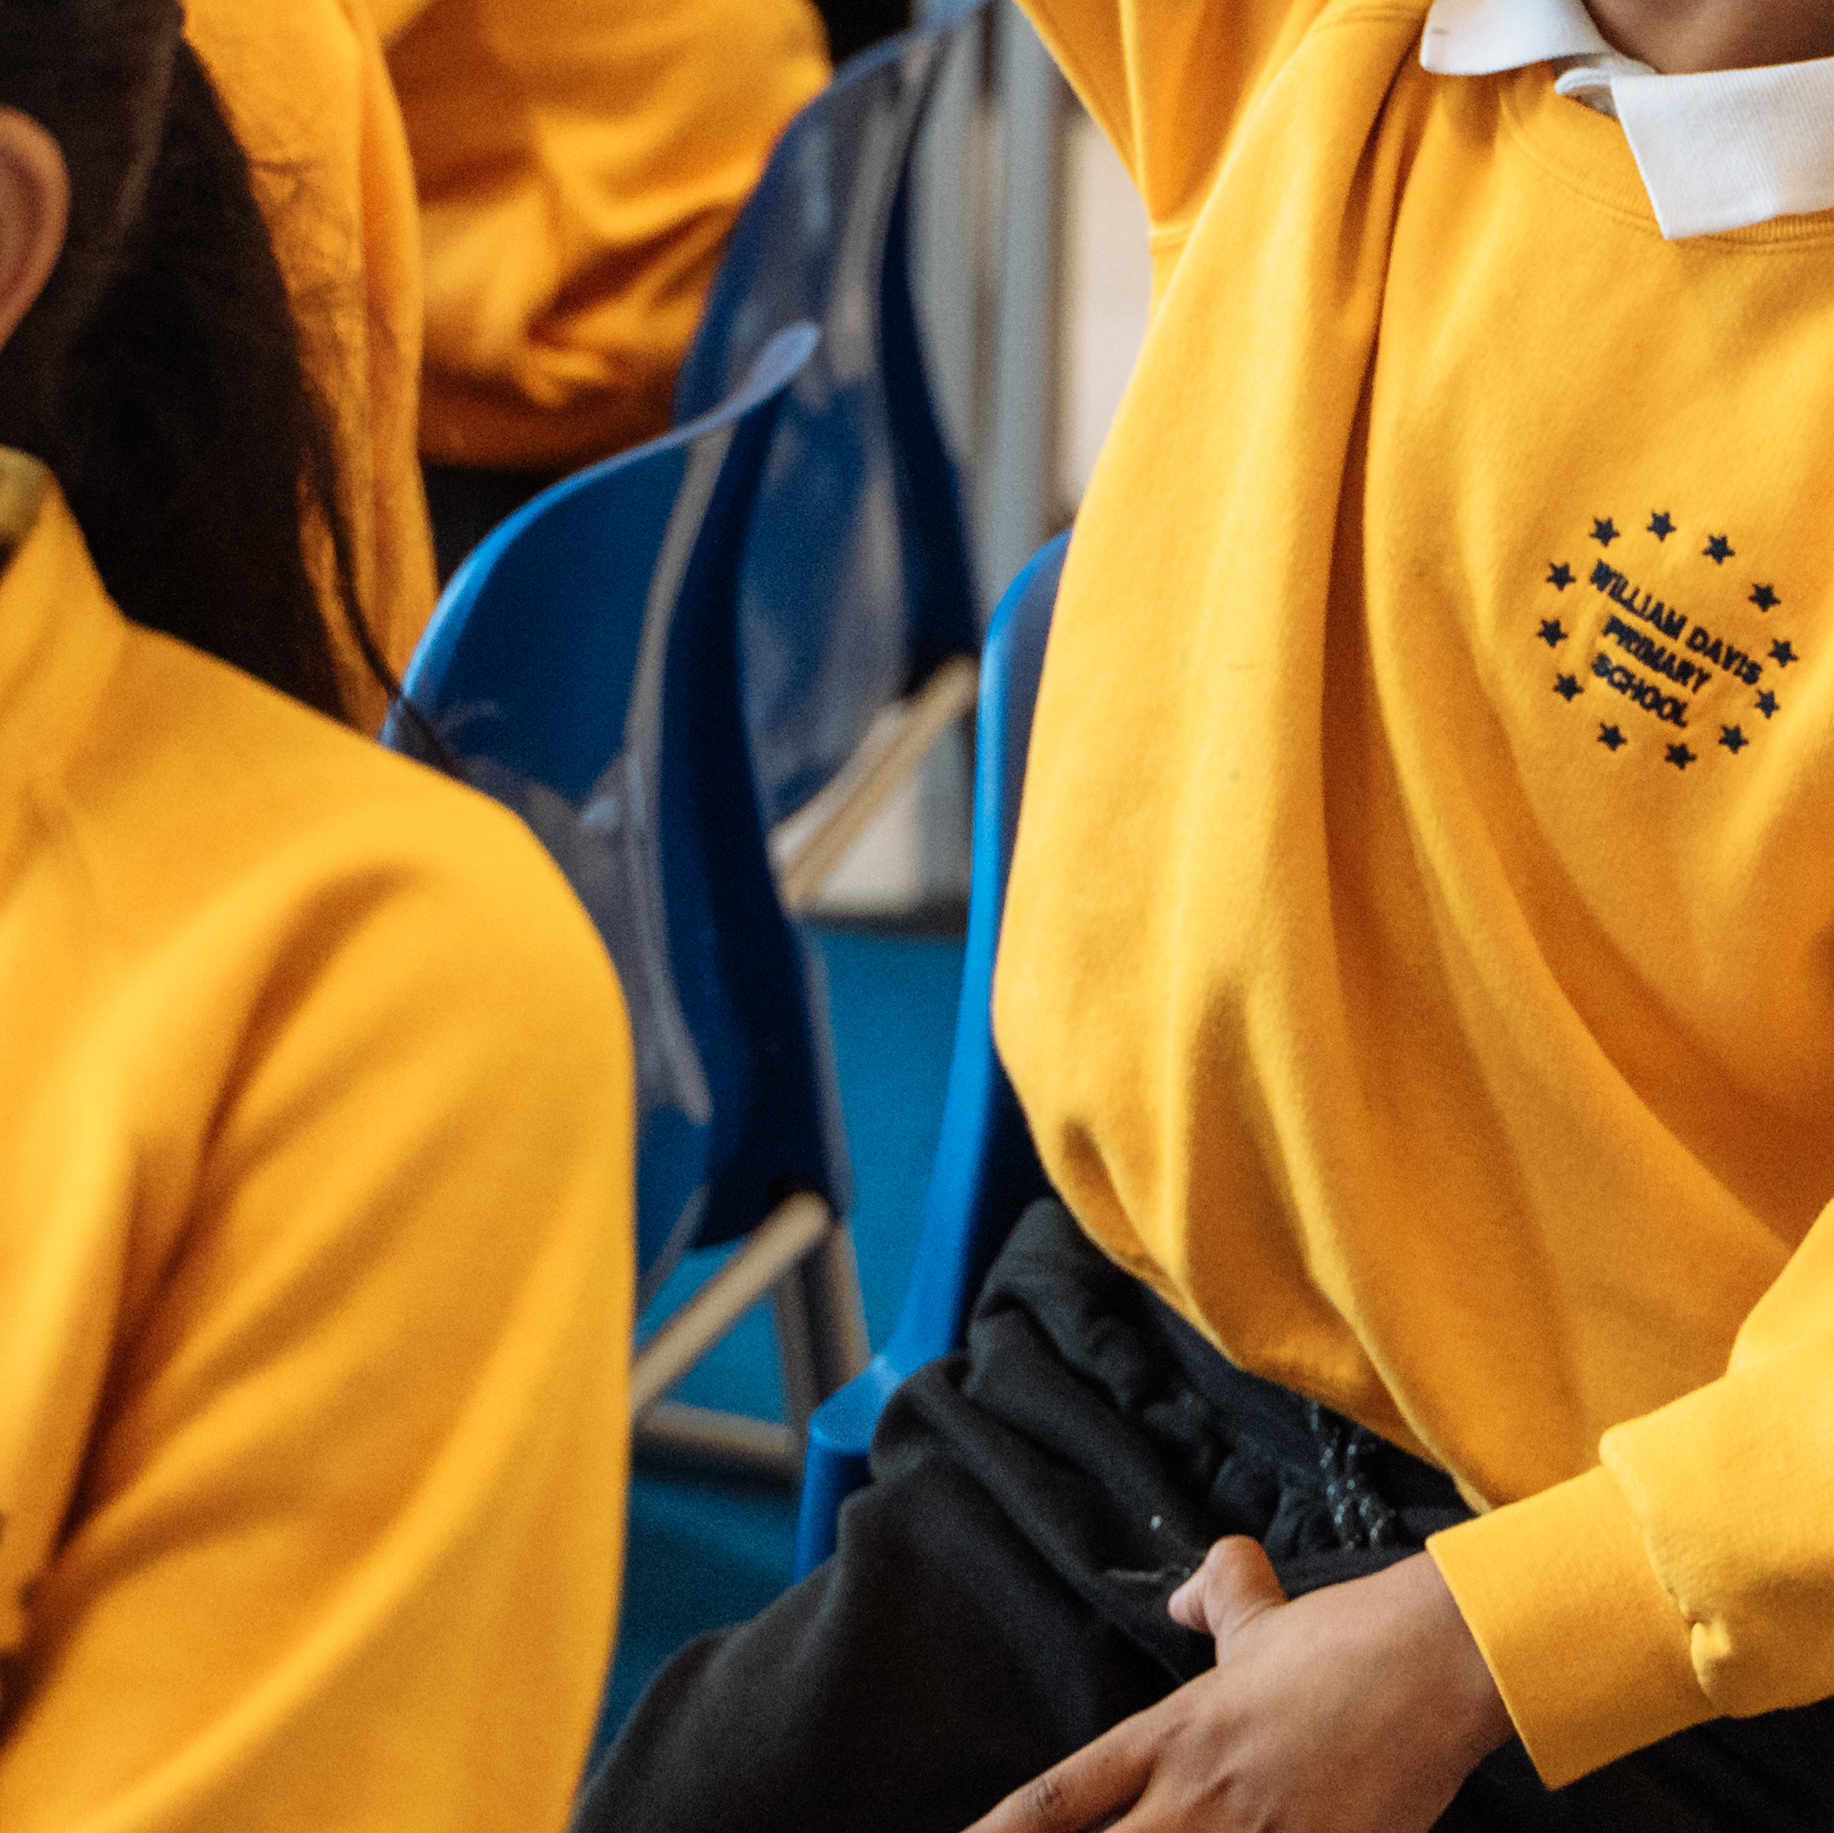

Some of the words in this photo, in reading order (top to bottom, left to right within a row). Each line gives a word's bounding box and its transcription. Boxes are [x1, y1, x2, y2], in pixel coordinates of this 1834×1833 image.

[1589, 559, 1688, 641] WILLIAM
[1685, 626, 1763, 685] DAVIS
[1602, 615, 1712, 694] PRIMARY
[1591, 652, 1688, 728] SCHOOL
